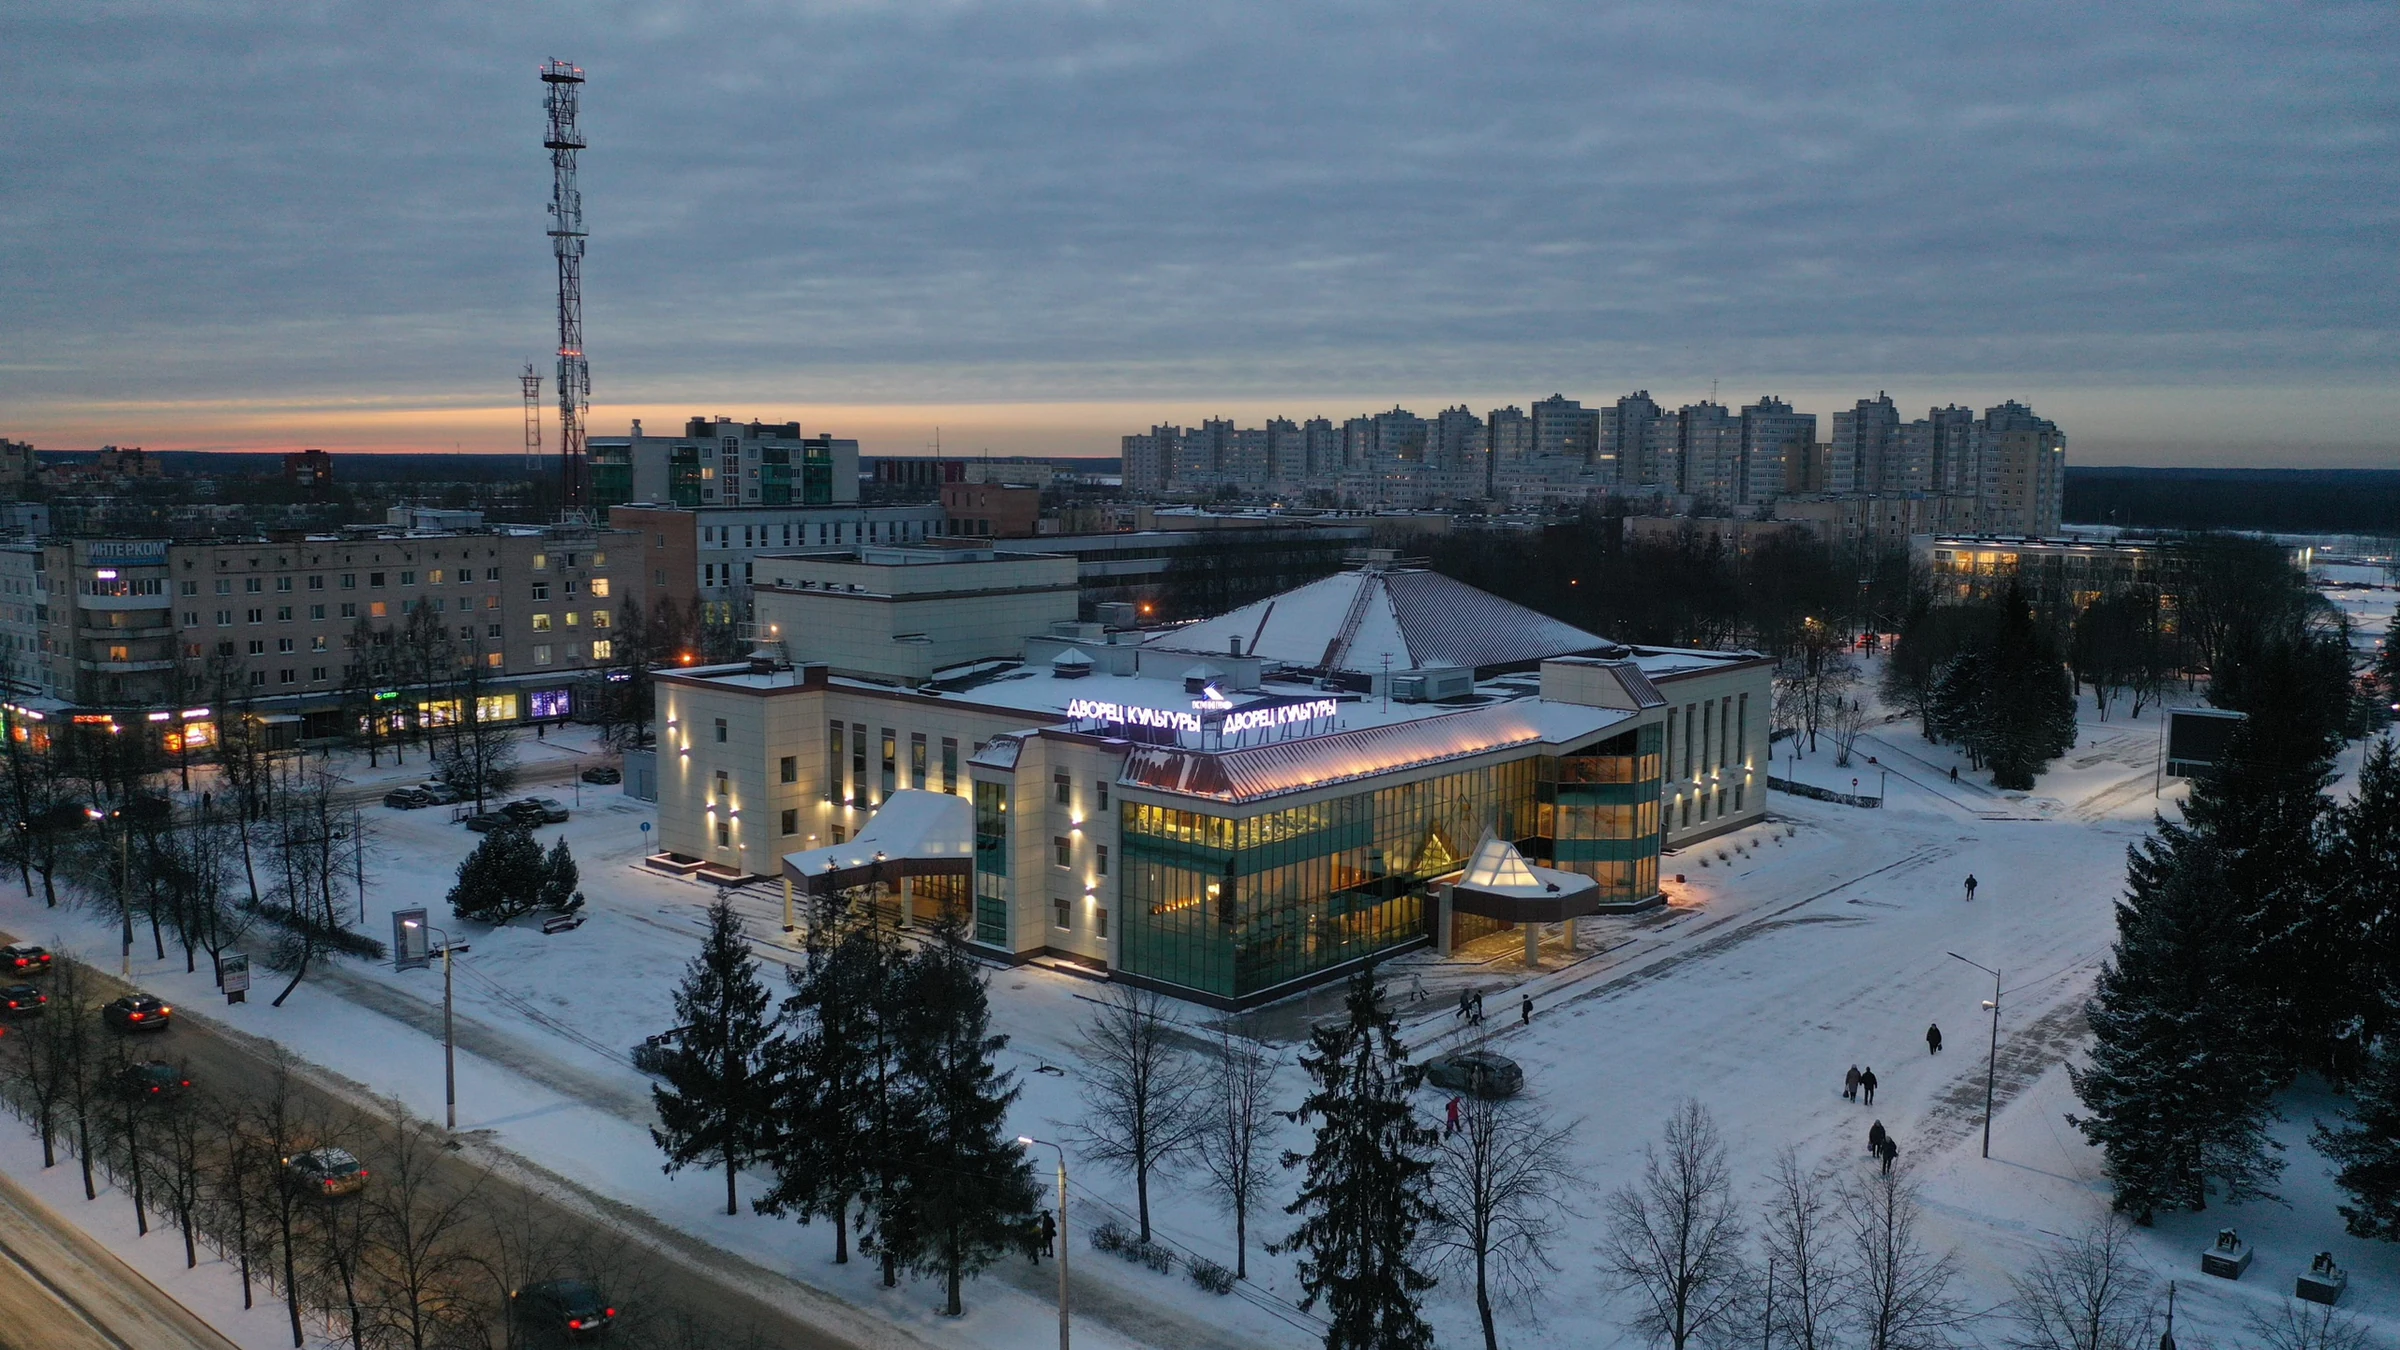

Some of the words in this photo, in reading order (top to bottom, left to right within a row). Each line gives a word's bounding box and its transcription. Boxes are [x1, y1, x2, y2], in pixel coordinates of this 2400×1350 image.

[90, 542, 165, 556] ИНТЕРКОМ
[1067, 699, 1124, 725] ДВОРЕЦ
[1127, 706, 1200, 732] КУЛЬТУРЫ
[1223, 707, 1276, 735] ДВОРЕЦ
[1278, 699, 1336, 724] КУЛЬТУРЫ
